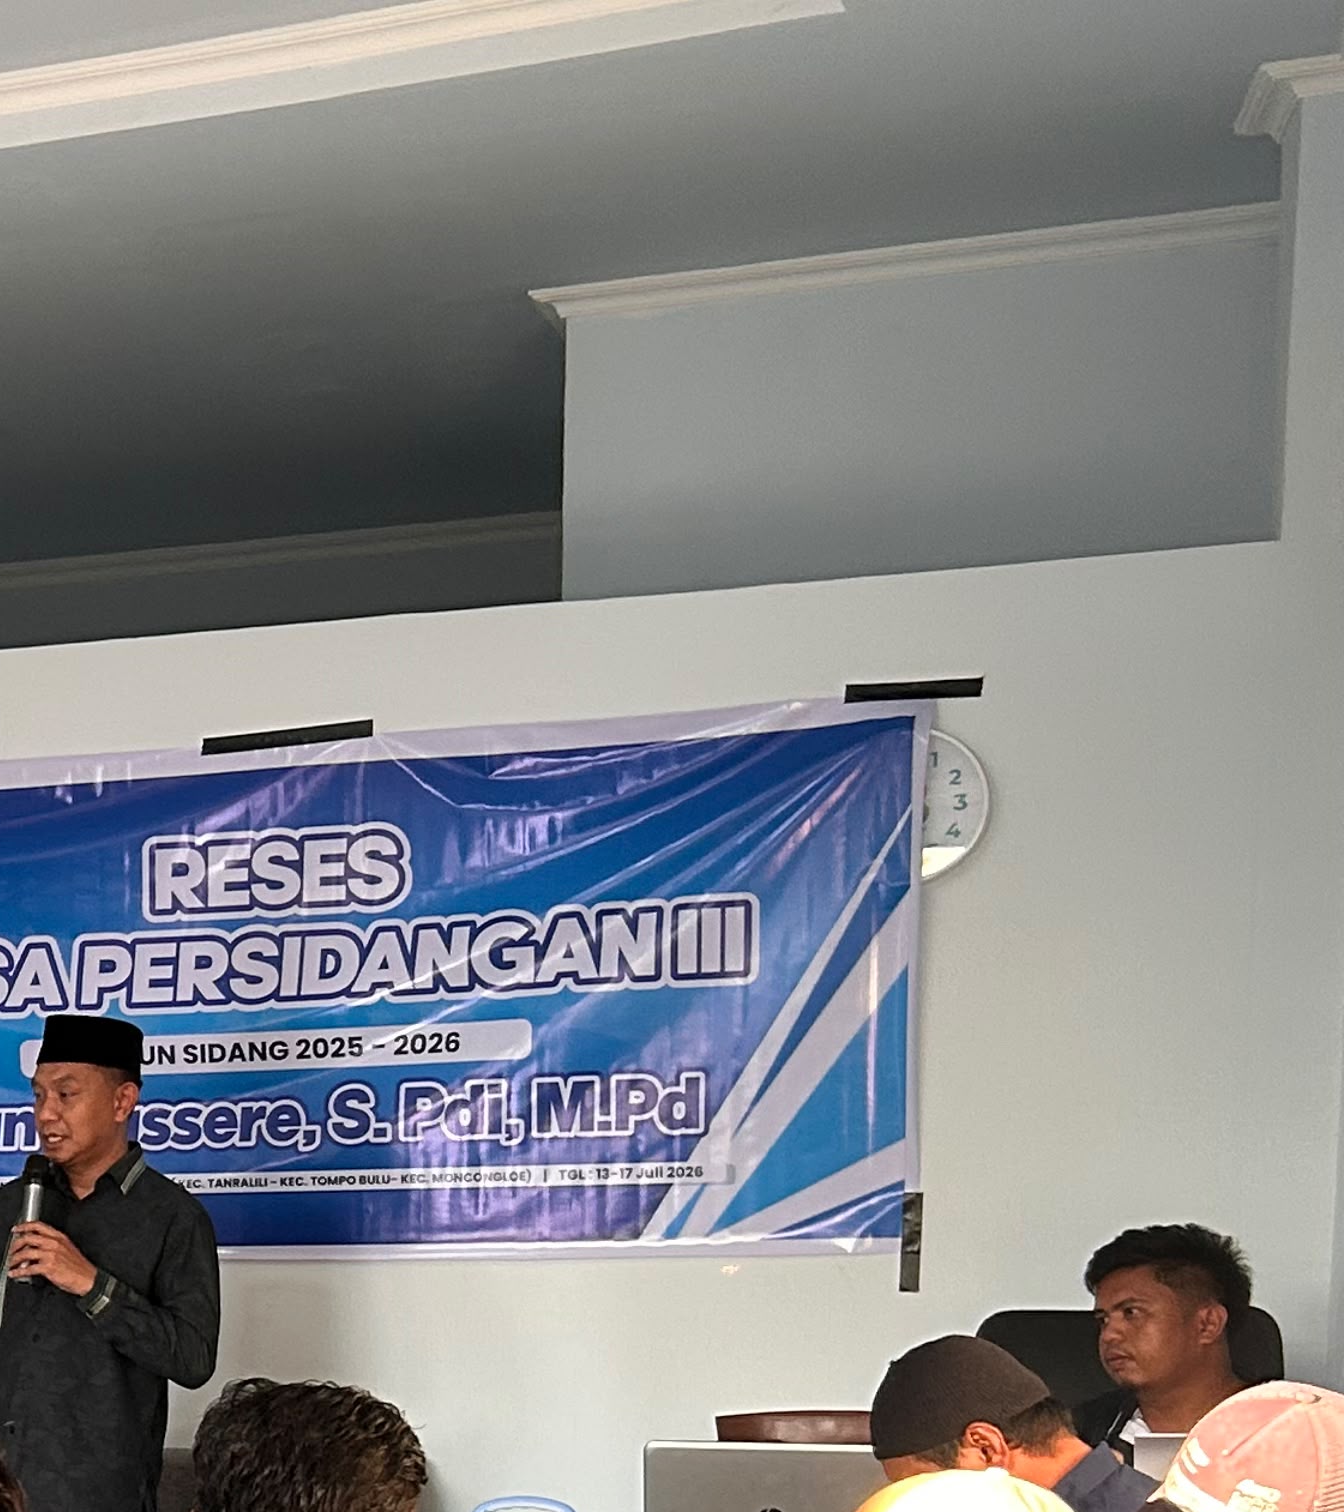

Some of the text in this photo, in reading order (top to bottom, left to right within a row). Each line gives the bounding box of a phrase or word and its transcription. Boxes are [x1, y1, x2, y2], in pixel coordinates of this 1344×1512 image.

[929, 752, 938, 768] 1
[949, 769, 962, 785] 2
[953, 794, 968, 811] 3
[945, 823, 962, 838] 4
[150, 827, 409, 917] RESES
[75, 906, 663, 1011] PERSIDANGAN
[672, 900, 751, 980] III
[182, 1040, 290, 1065] SIDANG
[295, 1036, 363, 1060] 2025
[394, 1031, 461, 1057] 2026
[127, 1101, 320, 1151] ssere,
[329, 1085, 391, 1145] S.
[208, 1177, 268, 1189] TANRALILI
[310, 1175, 357, 1186] TOMPO
[666, 1166, 704, 1179] 2026
